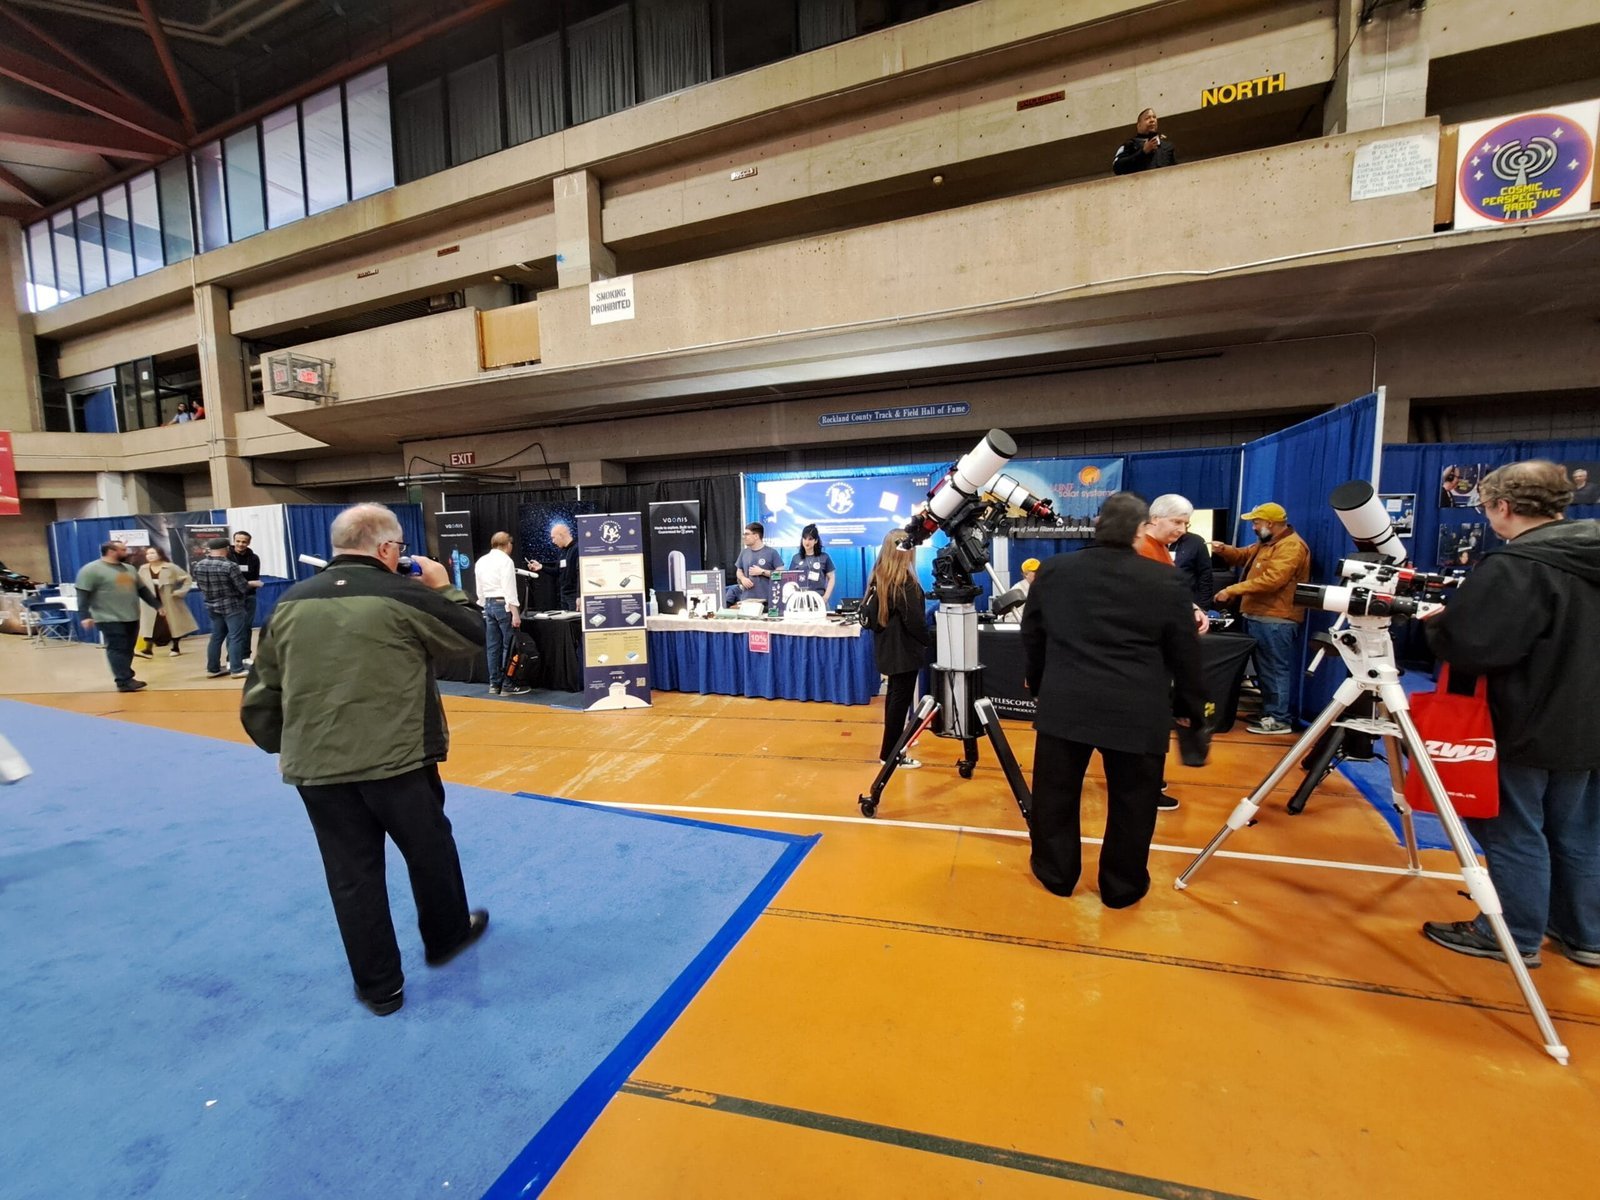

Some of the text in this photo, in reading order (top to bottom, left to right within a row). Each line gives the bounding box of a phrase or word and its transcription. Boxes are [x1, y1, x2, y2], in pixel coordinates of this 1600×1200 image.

[1202, 72, 1285, 108] NORTH
[1500, 182, 1543, 196] COSMIC
[1482, 188, 1561, 206] PERSPECTIVE
[1503, 200, 1537, 212] RADIO
[596, 288, 626, 302] SMOKING
[591, 299, 631, 315] PROHIBITED
[822, 404, 966, 424] Rockland County Track & Field Hall of Fame
[451, 452, 473, 465] EXIT
